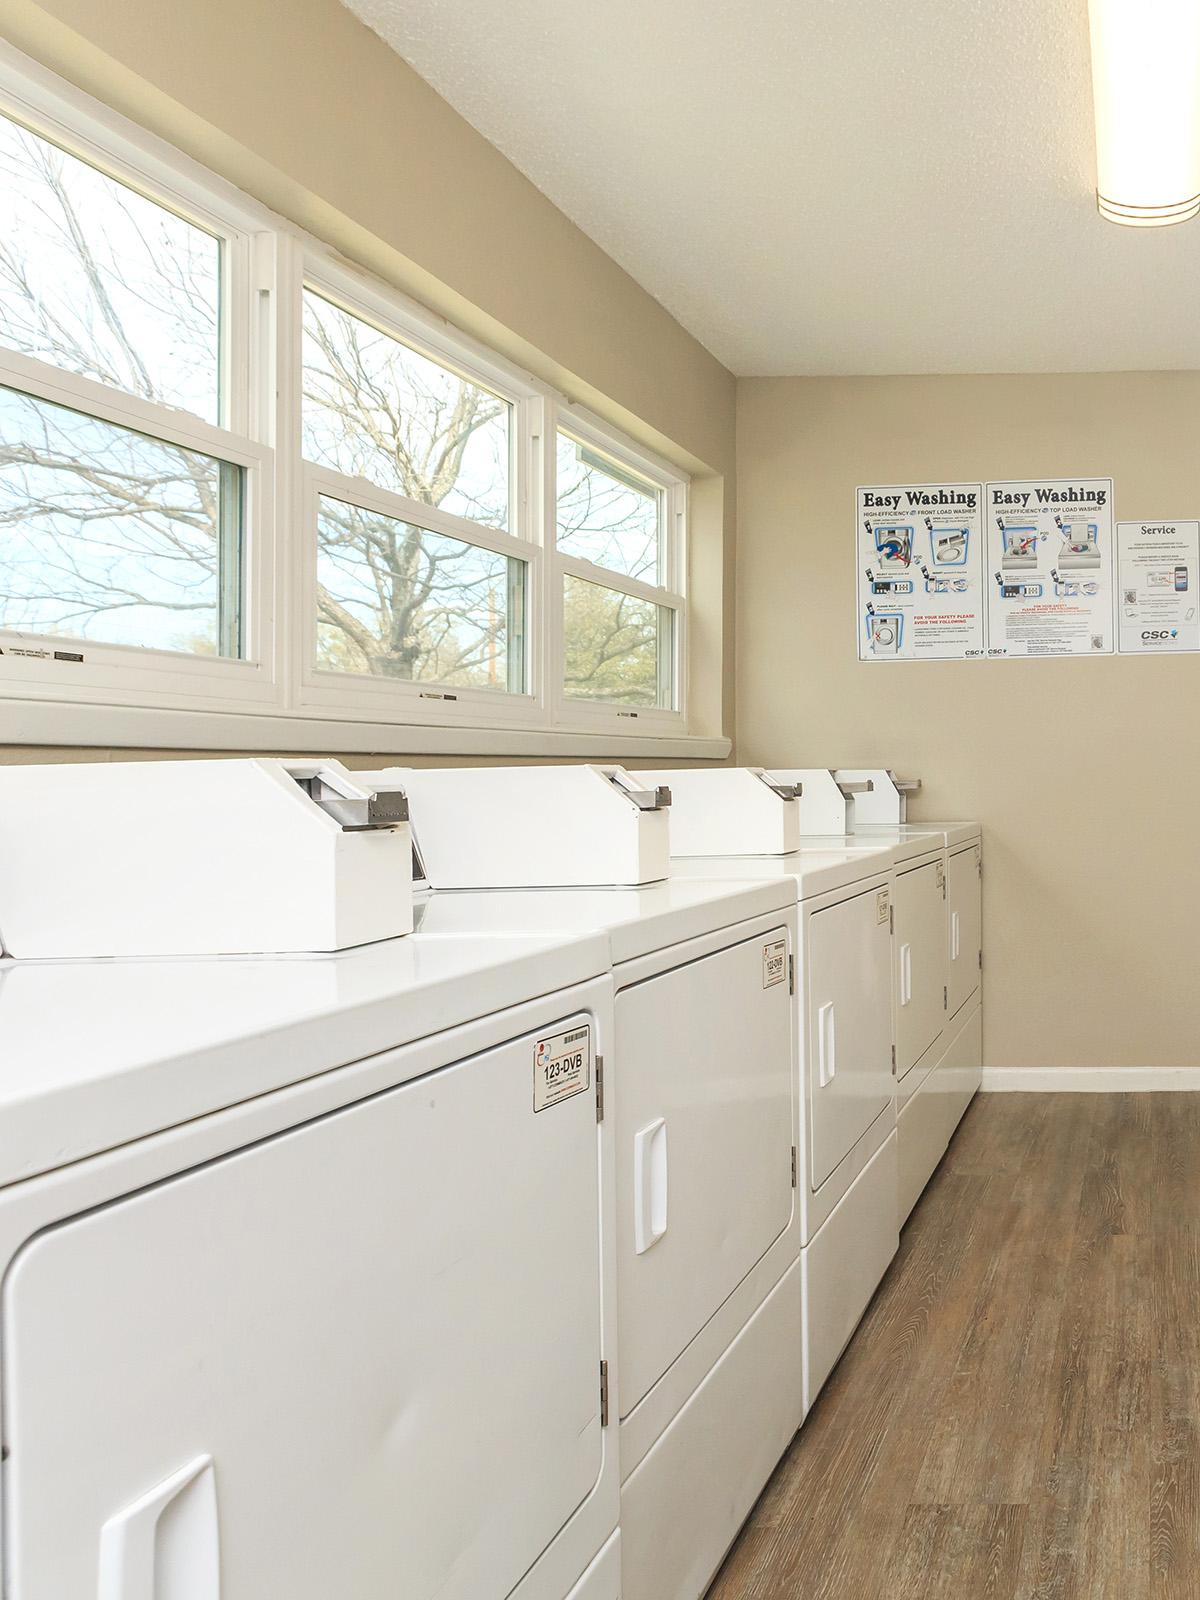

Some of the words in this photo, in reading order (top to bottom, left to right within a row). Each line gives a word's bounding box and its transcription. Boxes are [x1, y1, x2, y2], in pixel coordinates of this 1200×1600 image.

[863, 493, 902, 510] Easy
[905, 489, 977, 508] Washing
[992, 490, 1031, 507] Easy
[1034, 487, 1107, 505] Washing
[1141, 525, 1176, 535] Service
[1141, 630, 1169, 639] CSC
[544, 1053, 582, 1080] 123-DVB
